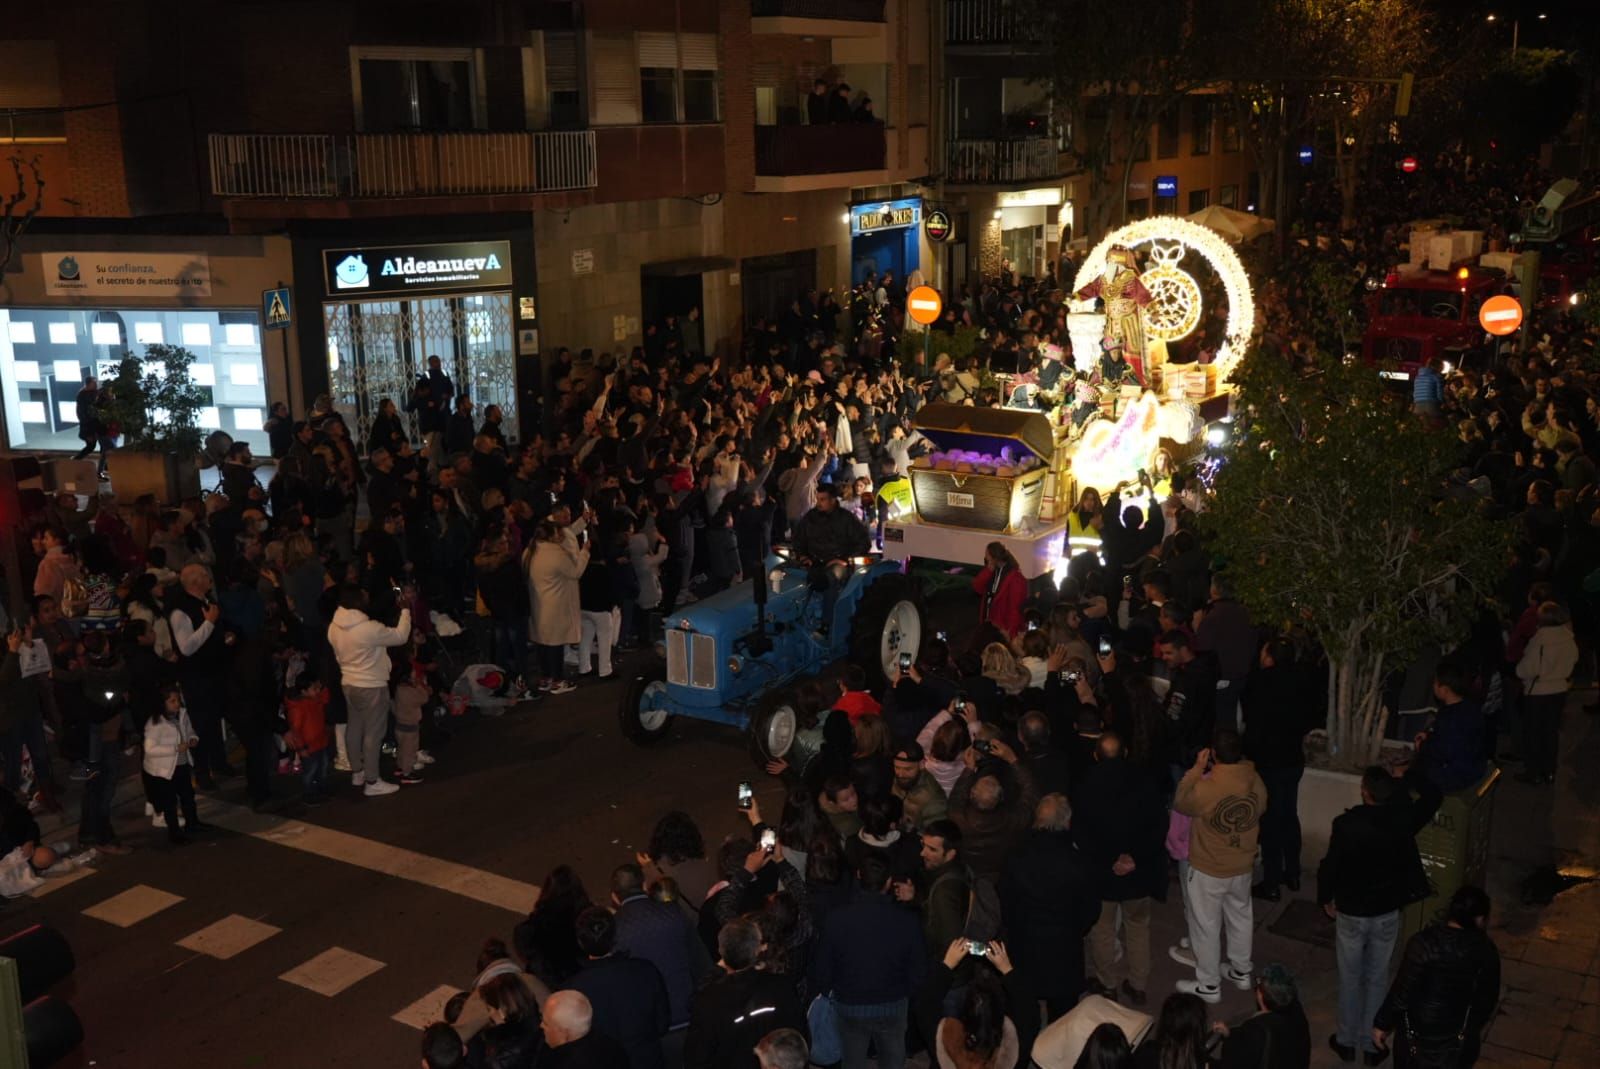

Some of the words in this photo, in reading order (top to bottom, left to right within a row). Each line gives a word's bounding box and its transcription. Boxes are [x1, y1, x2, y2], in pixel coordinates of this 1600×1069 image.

[96, 264, 106, 273] Su
[381, 254, 502, 276] AldeanuevA
[97, 276, 105, 285] el
[106, 277, 135, 286] secreto
[137, 276, 147, 286] de
[149, 278, 180, 286] nuestro
[405, 276, 435, 284] Servicios
